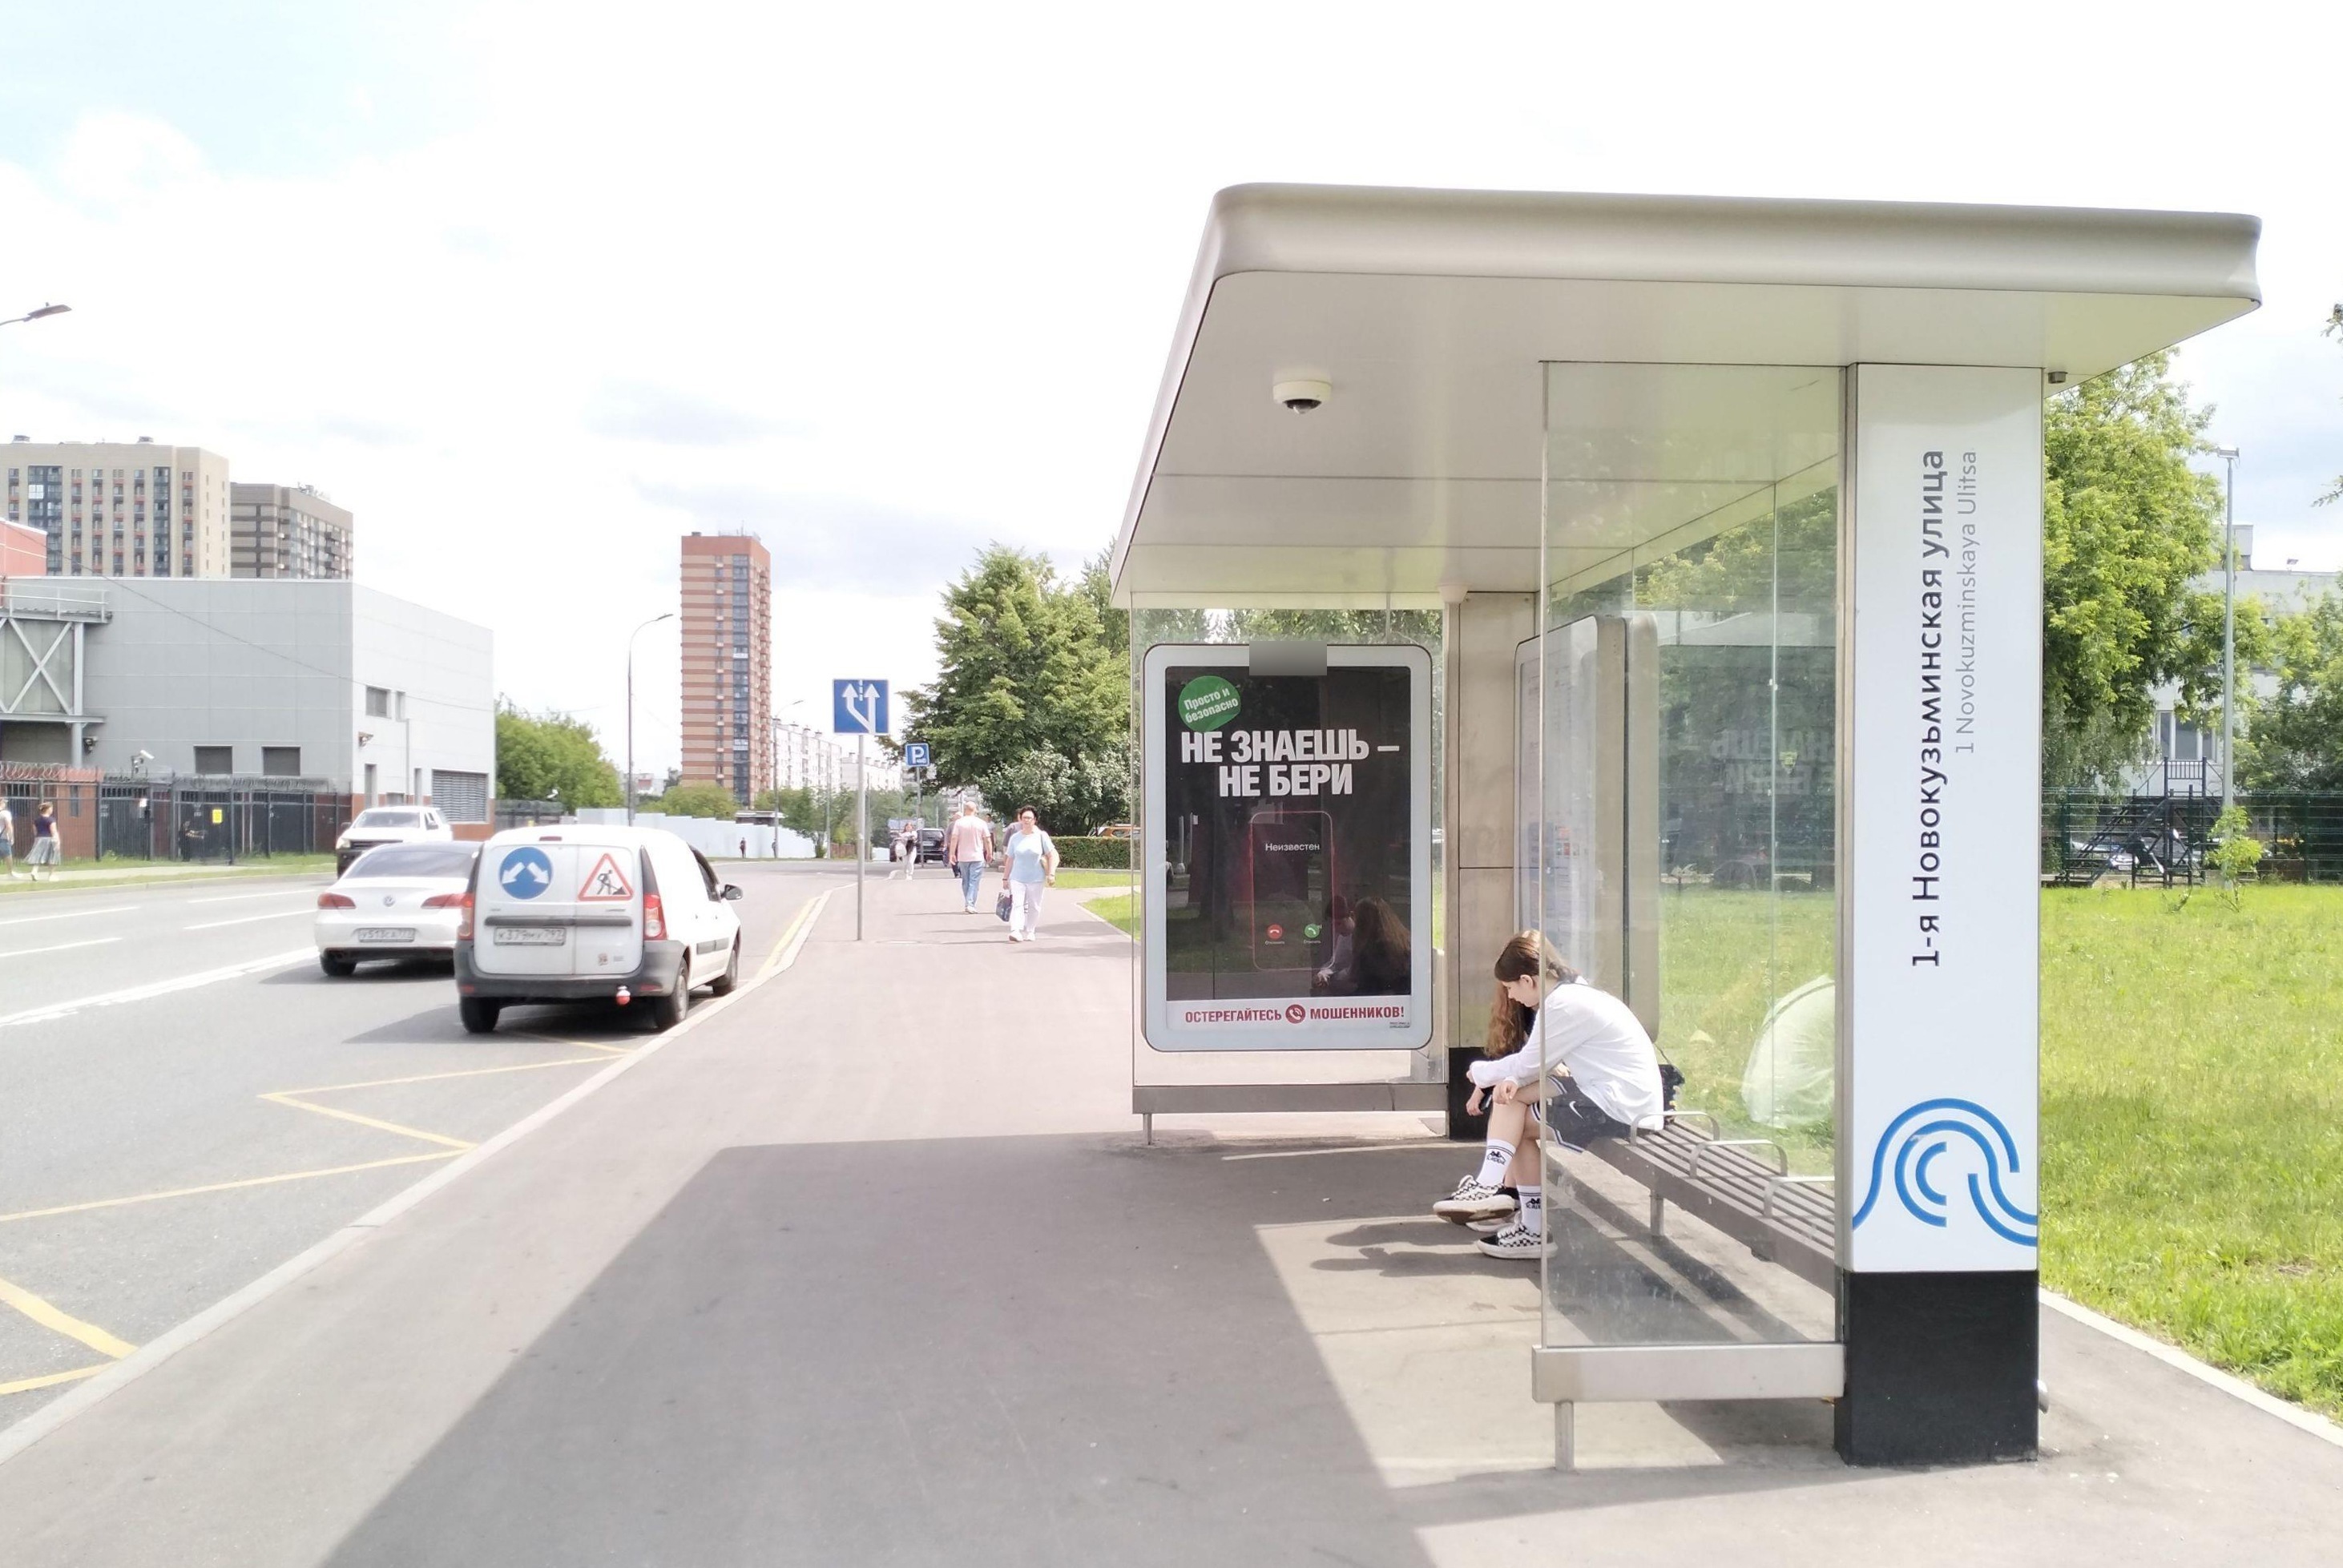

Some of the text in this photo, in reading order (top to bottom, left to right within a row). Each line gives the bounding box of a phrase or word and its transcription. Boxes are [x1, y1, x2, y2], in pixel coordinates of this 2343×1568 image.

[1957, 452, 1976, 514] Ulitsa
[1955, 523, 1980, 734] Novokuzminskaya
[1184, 691, 1221, 711] Просто
[1185, 698, 1239, 724] безопасно
[1912, 451, 1950, 966] 1-я Новокузьминская улица
[1181, 731, 1223, 763] НЕ
[1230, 728, 1369, 763] ЗНАЕШЬ
[1219, 764, 1353, 797] НЕ БЕРИ
[1265, 843, 1321, 852] Неизвестен
[1185, 1006, 1404, 1023] ОСТЕРЕГАЙТЕСЬ МОШЕННИКОВ!
